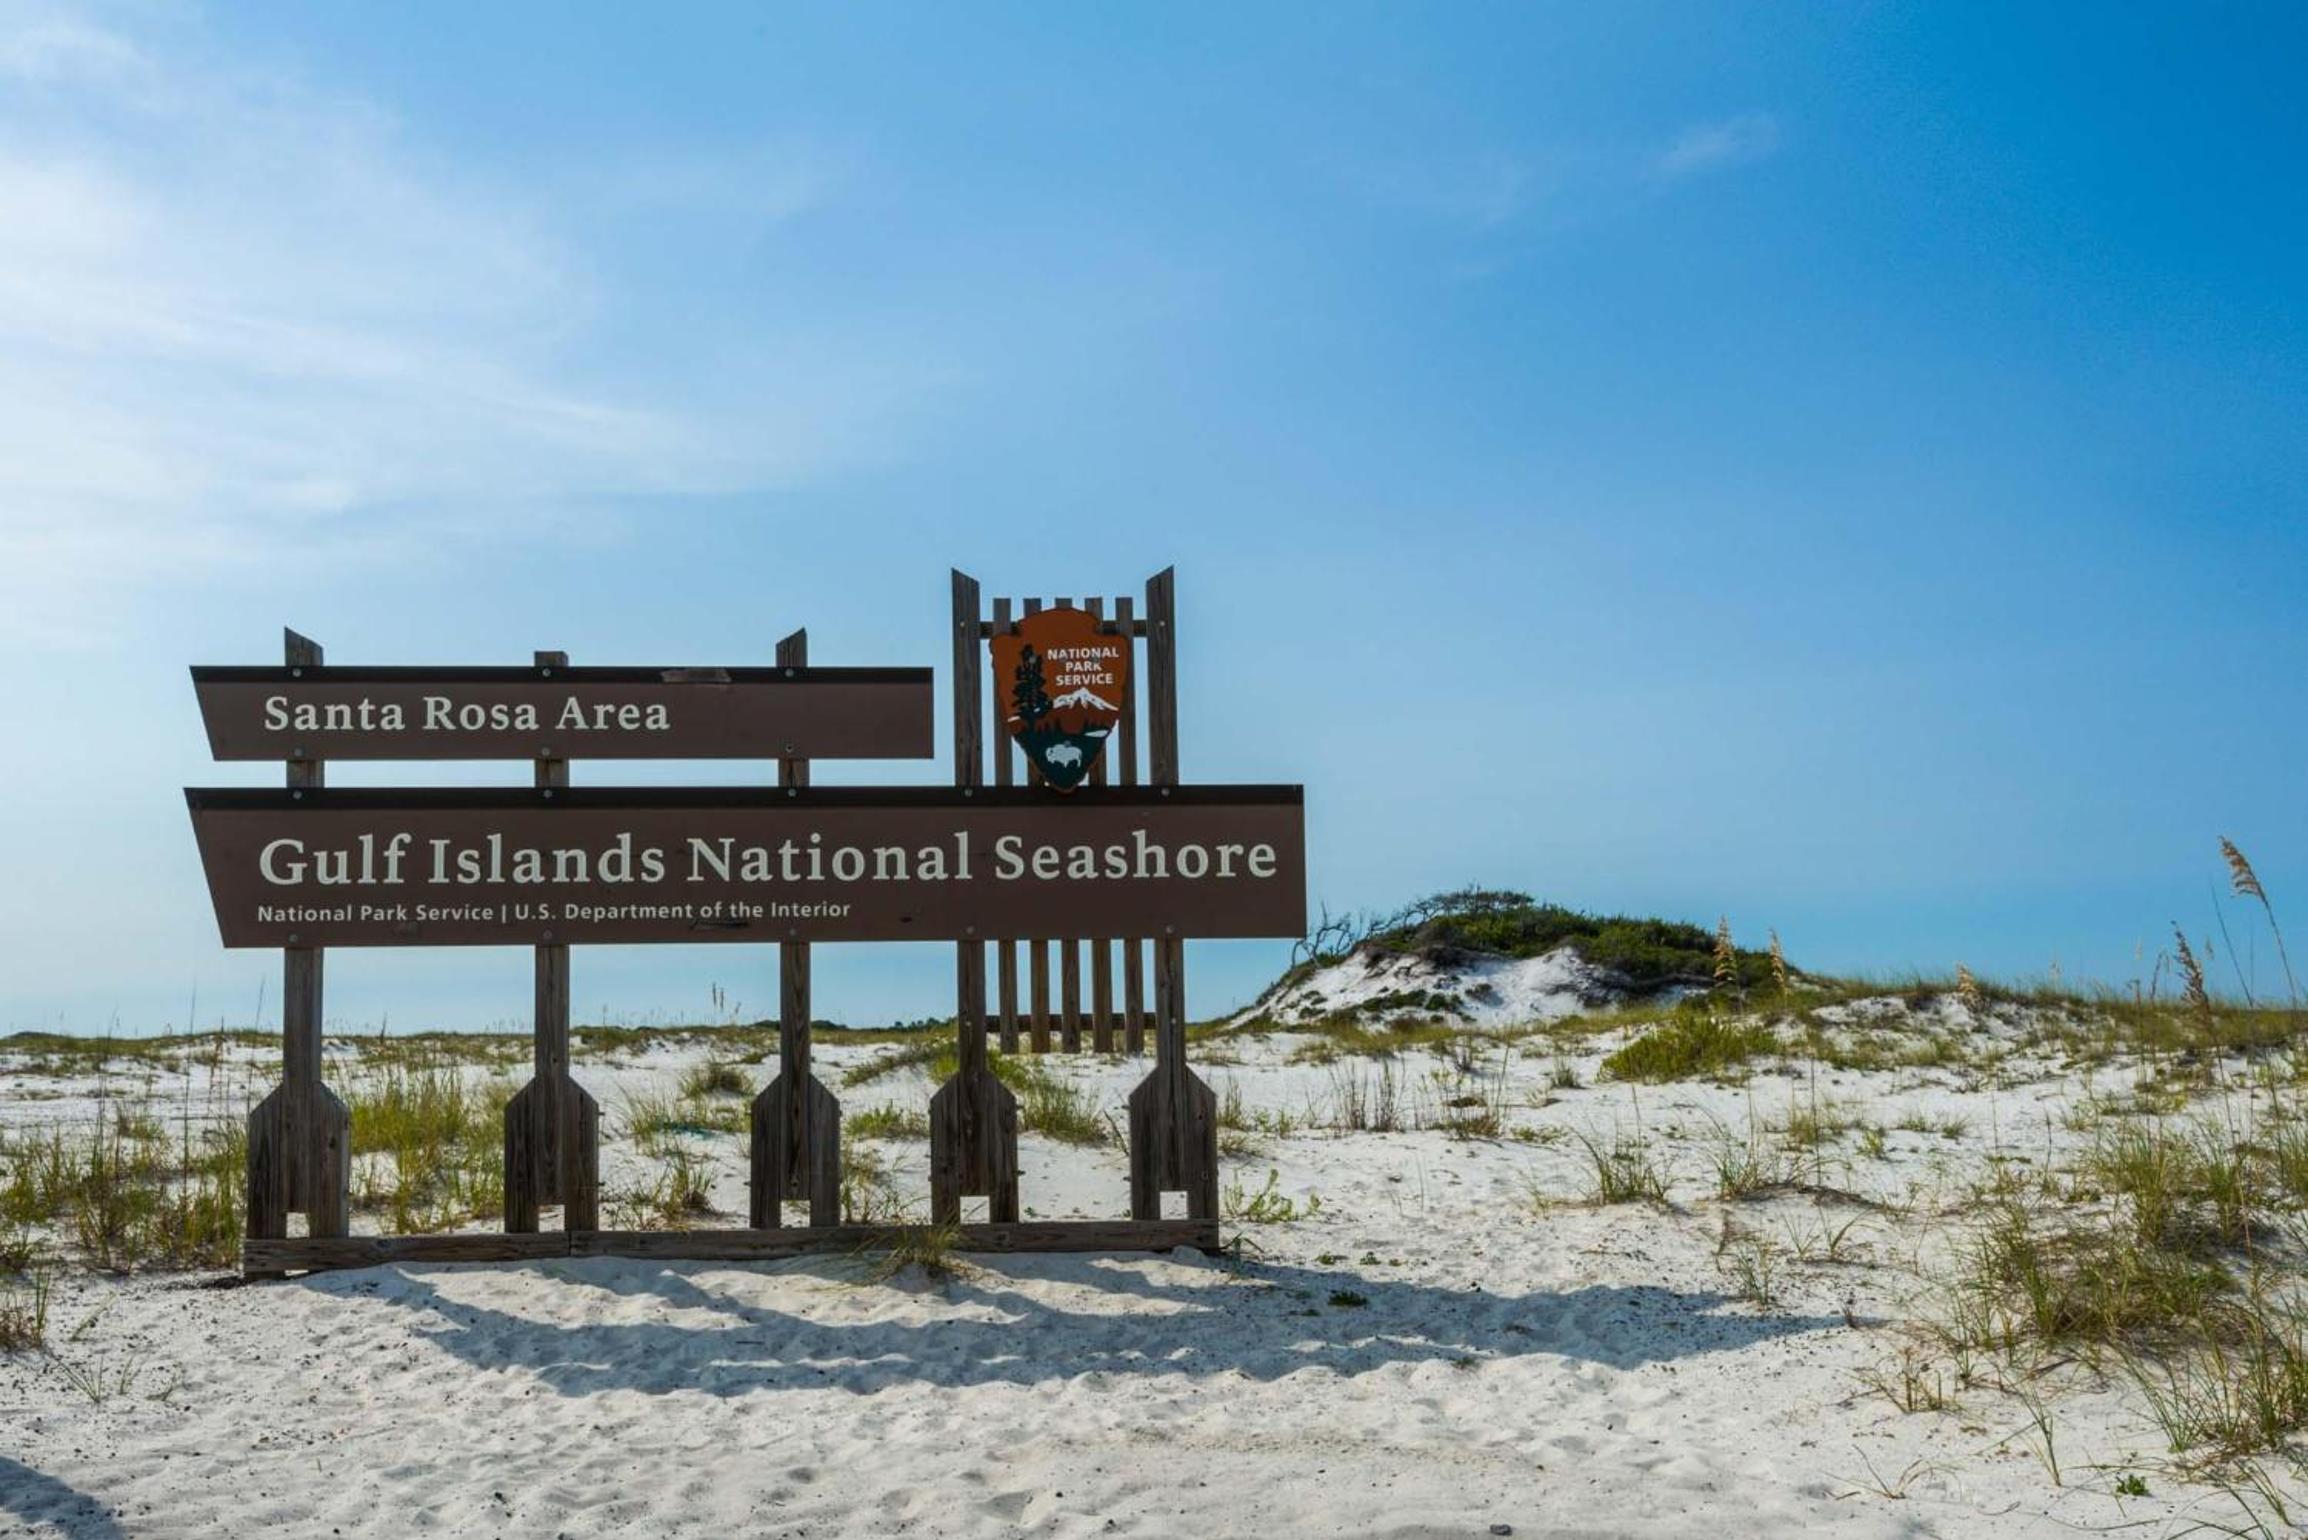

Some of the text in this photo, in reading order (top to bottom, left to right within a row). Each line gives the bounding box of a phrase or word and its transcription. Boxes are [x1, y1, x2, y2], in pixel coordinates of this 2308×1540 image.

[1047, 647, 1119, 660] NATIONAL
[1065, 660, 1102, 672] PARK
[1055, 673, 1113, 686] SERVICE
[264, 696, 670, 731] Santa Rosa Area
[259, 829, 1277, 885] Gulf Islands National Seashore
[257, 904, 352, 922] National
[360, 904, 407, 921] Park
[415, 903, 494, 921] Service
[515, 903, 556, 920] U.S.
[565, 903, 693, 923] Department
[699, 901, 722, 918] of
[729, 901, 763, 918] the
[771, 900, 851, 918] Interior
